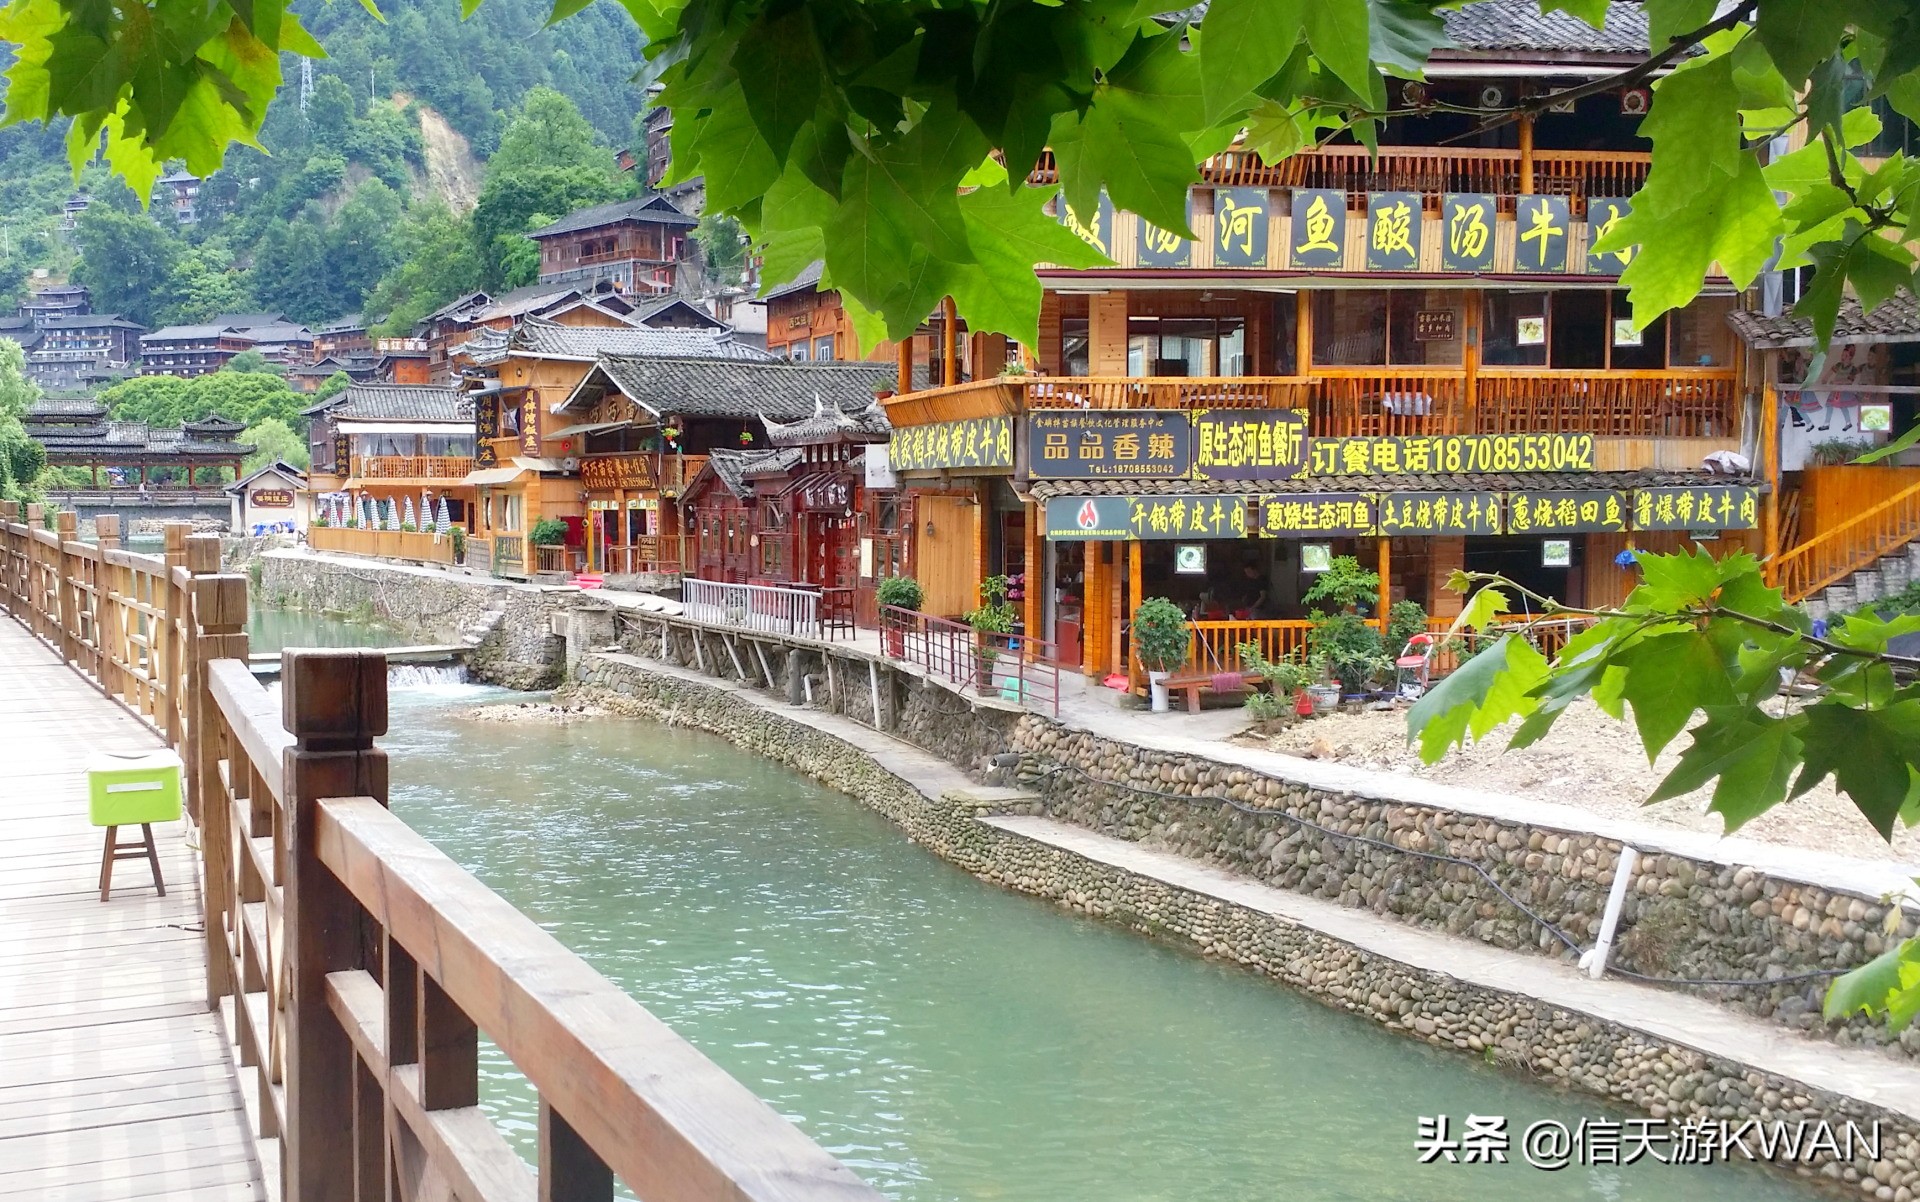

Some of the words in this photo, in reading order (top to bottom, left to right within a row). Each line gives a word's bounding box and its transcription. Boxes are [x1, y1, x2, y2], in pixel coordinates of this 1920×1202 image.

[889, 419, 1010, 467] 我家稻草烧带皮牛肉
[1044, 433, 1175, 459] 品品香辣
[1198, 421, 1303, 467] 原生态河鱼餐厅
[1311, 435, 1594, 475] 订餐电话18708553042
[1130, 498, 1244, 535] 干锅带皮牛肉
[1266, 501, 1370, 530] 葱烧生态河鱼
[1382, 495, 1500, 531] 土豆烧带皮牛肉
[1512, 491, 1623, 531] 葱烧稻田鱼
[1634, 490, 1756, 527] 酱爆带皮牛肉
